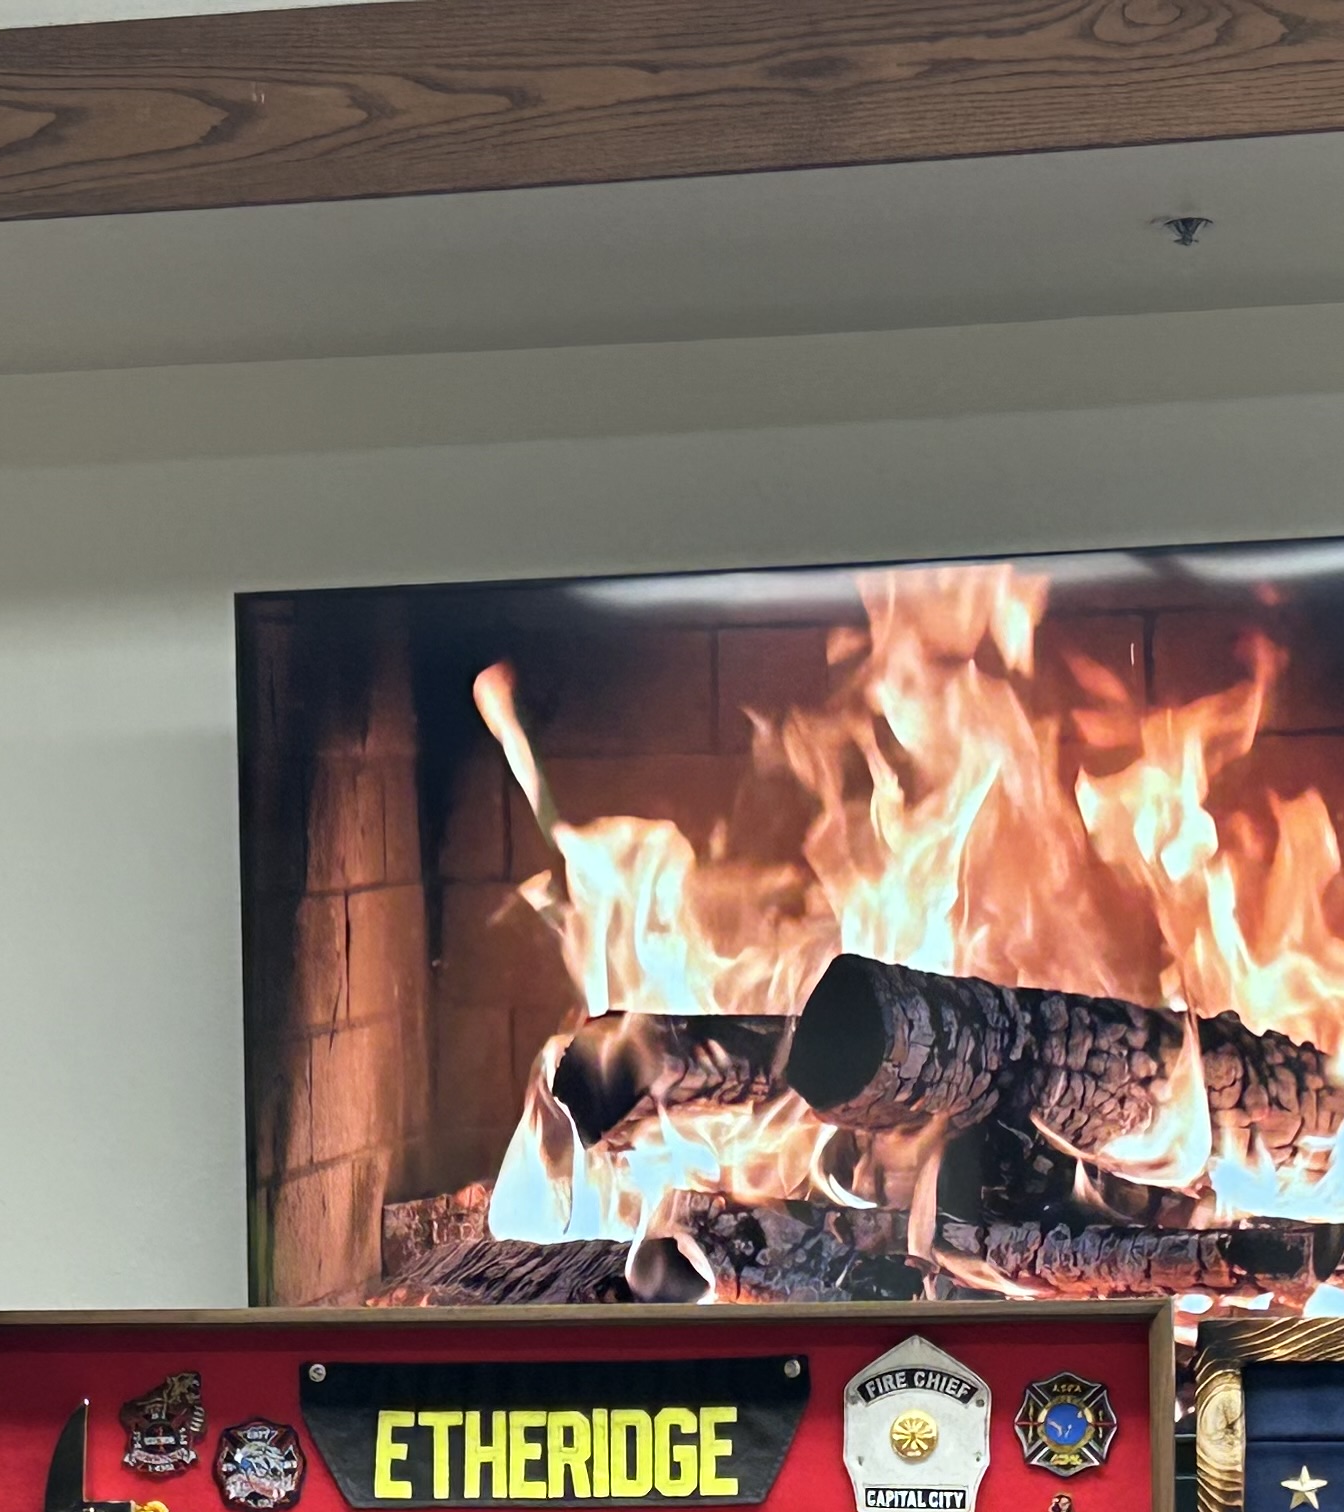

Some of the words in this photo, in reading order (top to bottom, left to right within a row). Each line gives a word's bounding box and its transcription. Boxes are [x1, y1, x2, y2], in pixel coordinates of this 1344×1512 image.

[865, 1371, 906, 1398] FIRE
[914, 1371, 971, 1398] CHIEF
[374, 1406, 738, 1499] ETHERIDGE
[866, 1490, 927, 1508] CAPITAL
[929, 1491, 964, 1509] CITY
